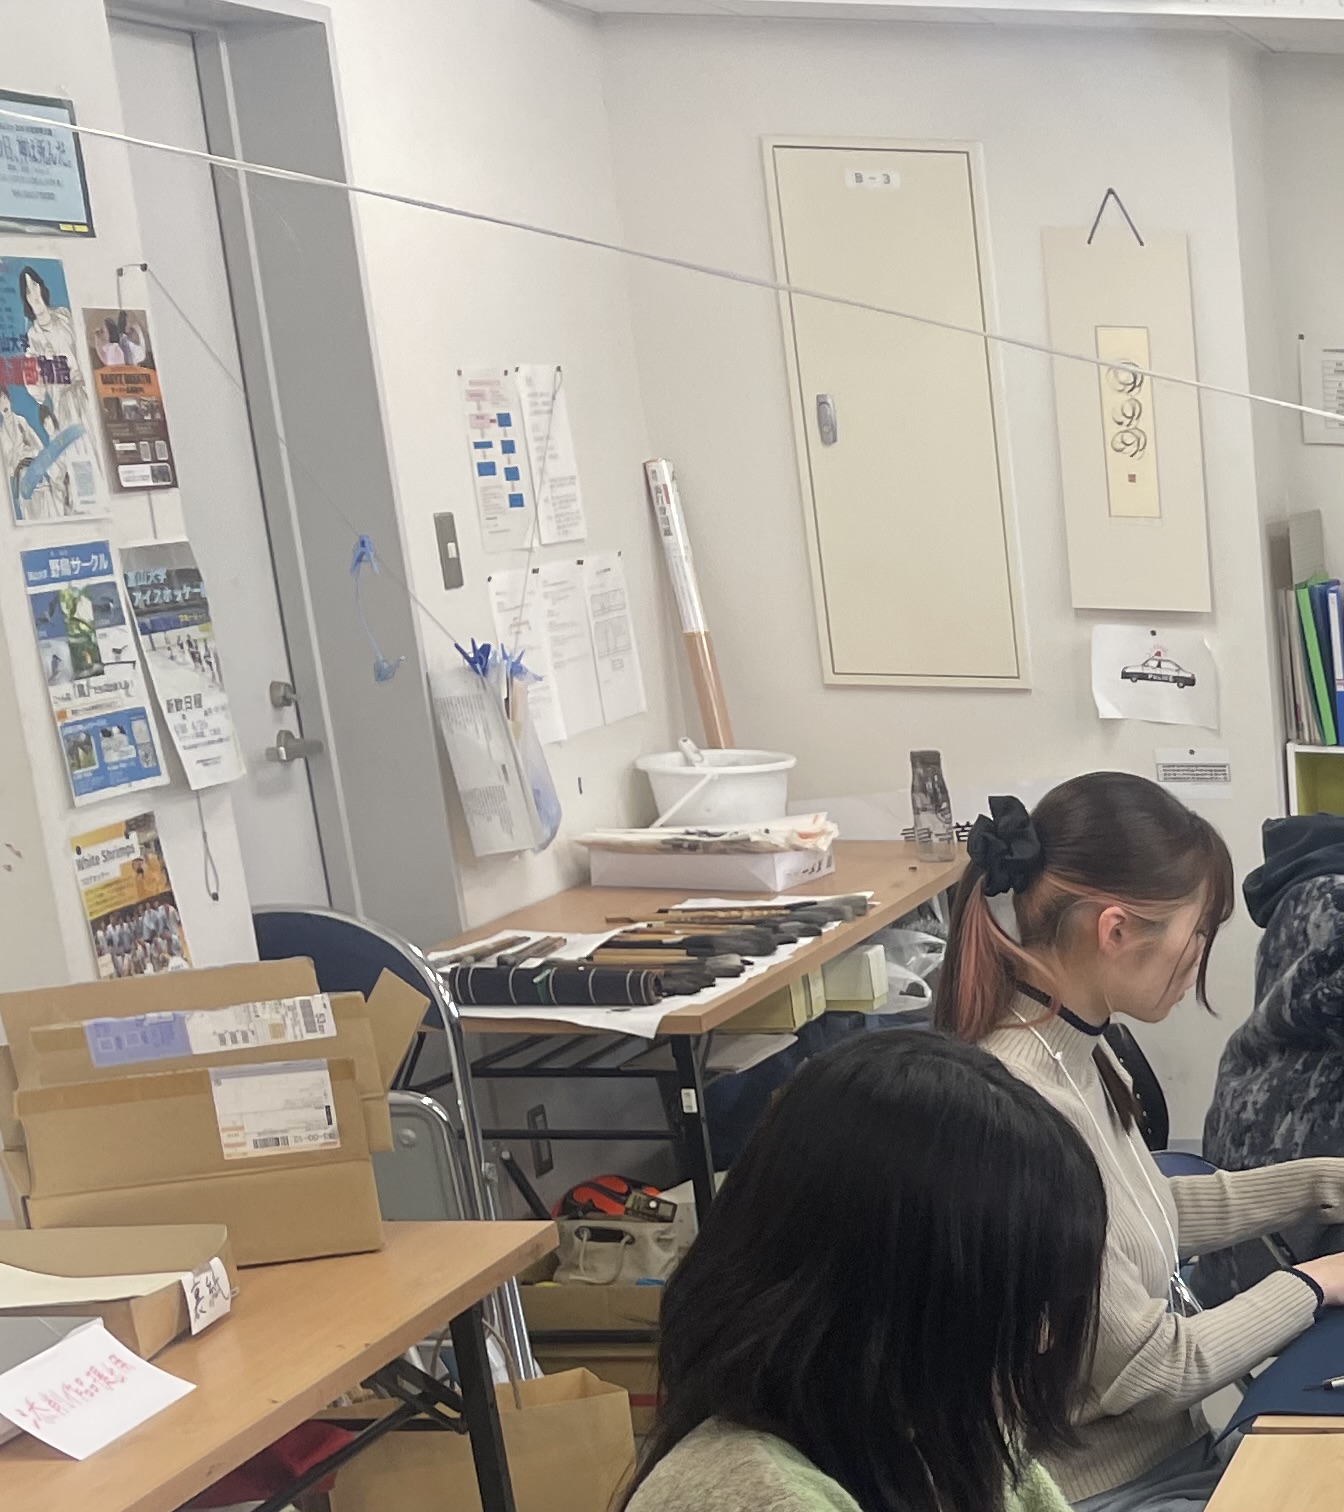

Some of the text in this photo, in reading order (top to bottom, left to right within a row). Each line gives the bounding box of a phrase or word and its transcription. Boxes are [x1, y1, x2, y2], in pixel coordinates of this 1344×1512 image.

[48, 553, 109, 579] 野鳥サークル
